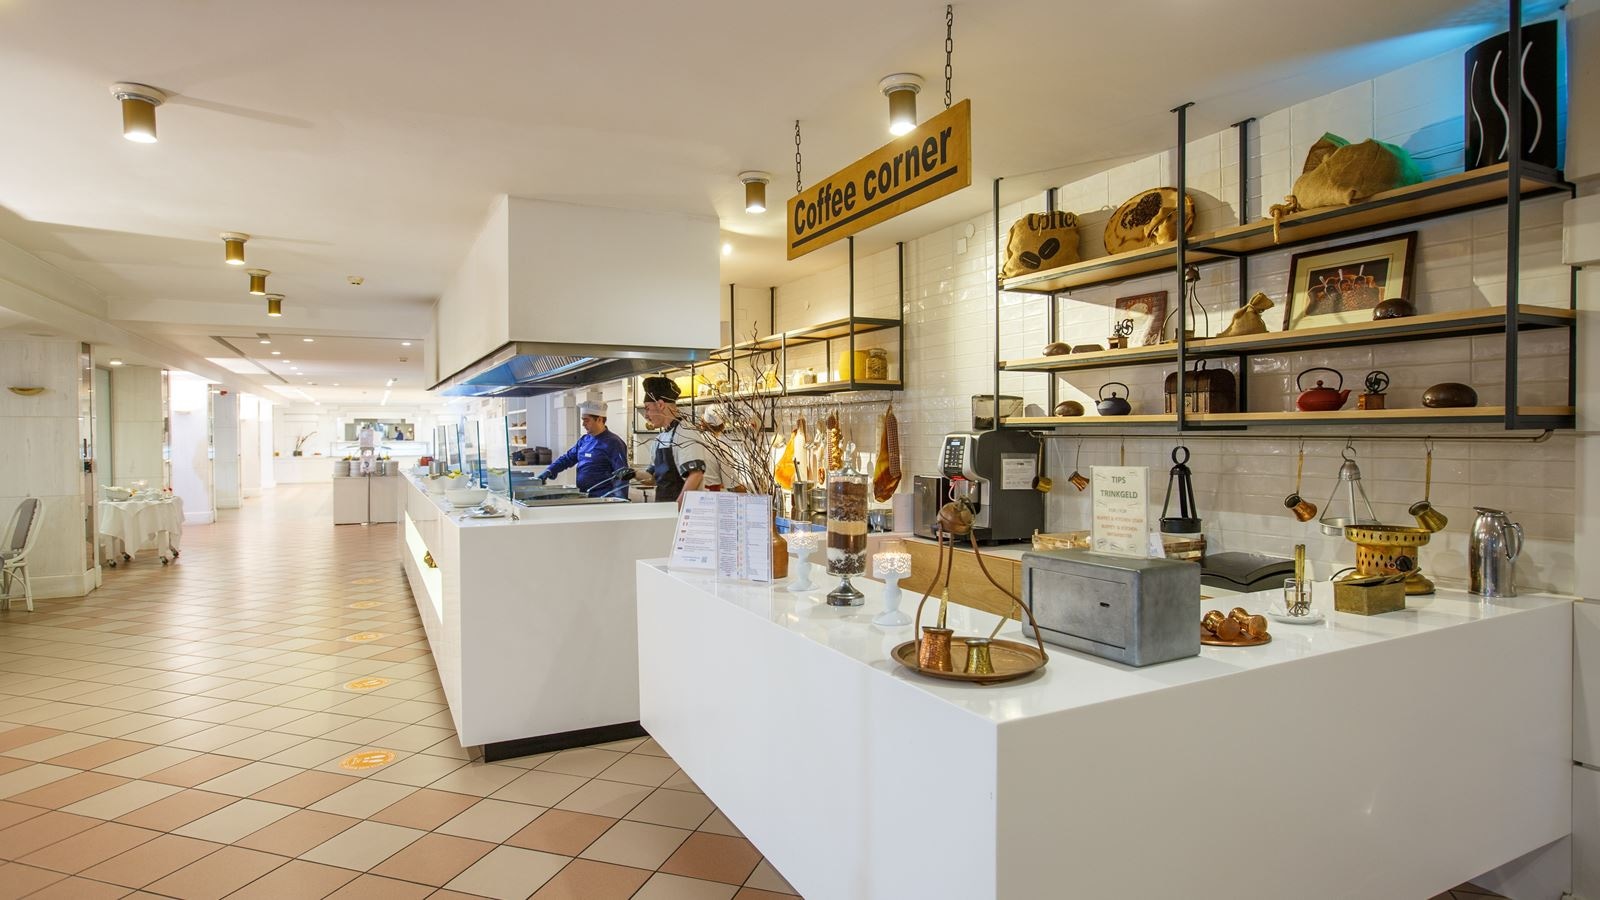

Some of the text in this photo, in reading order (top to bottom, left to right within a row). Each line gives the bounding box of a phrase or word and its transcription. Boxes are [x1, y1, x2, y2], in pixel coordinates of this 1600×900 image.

[794, 126, 952, 235] Coffee corner
[1111, 476, 1126, 484] TIPS
[1100, 489, 1138, 499] TRINKGELD
